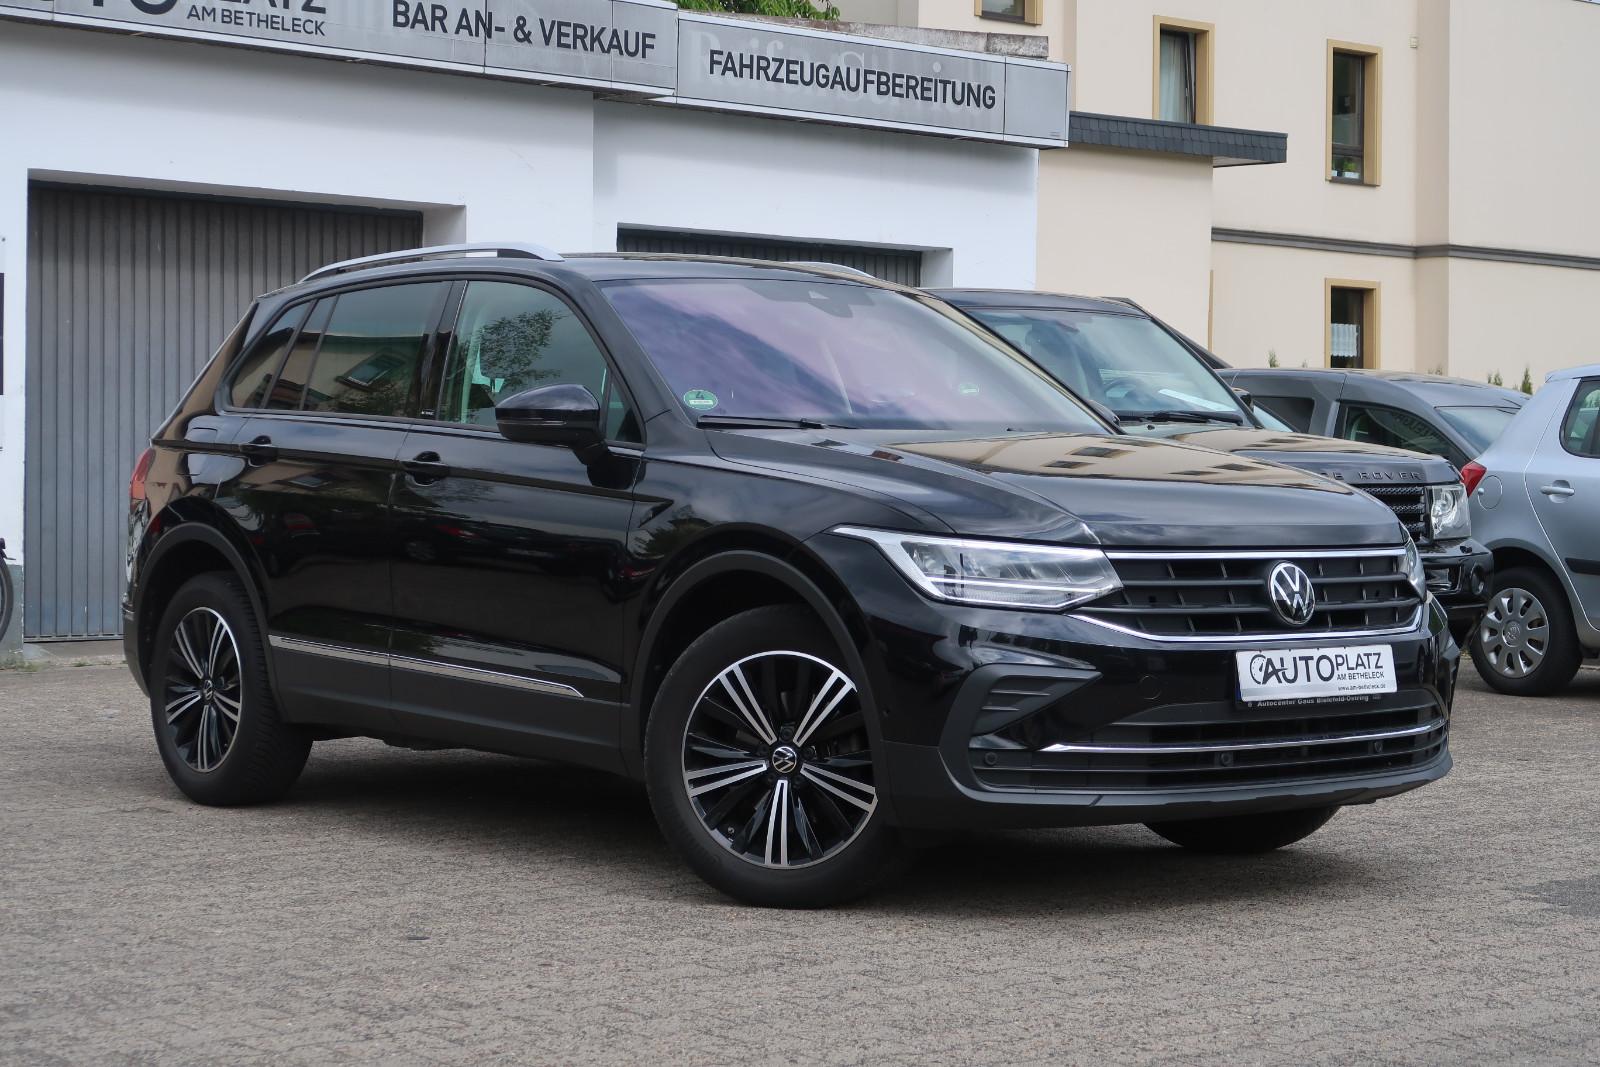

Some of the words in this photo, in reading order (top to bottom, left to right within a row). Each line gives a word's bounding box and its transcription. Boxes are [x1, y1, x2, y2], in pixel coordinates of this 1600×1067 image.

[186, 5, 217, 22] AM
[221, 9, 326, 36] BETHELECK
[392, 0, 448, 33] BAR
[454, 8, 505, 39] AN-
[513, 16, 532, 44] &
[539, 18, 656, 58] VERKAUF
[709, 49, 996, 109] FAHRZEUGAUFBEREITUNG
[1358, 471, 1420, 480] ROVER
